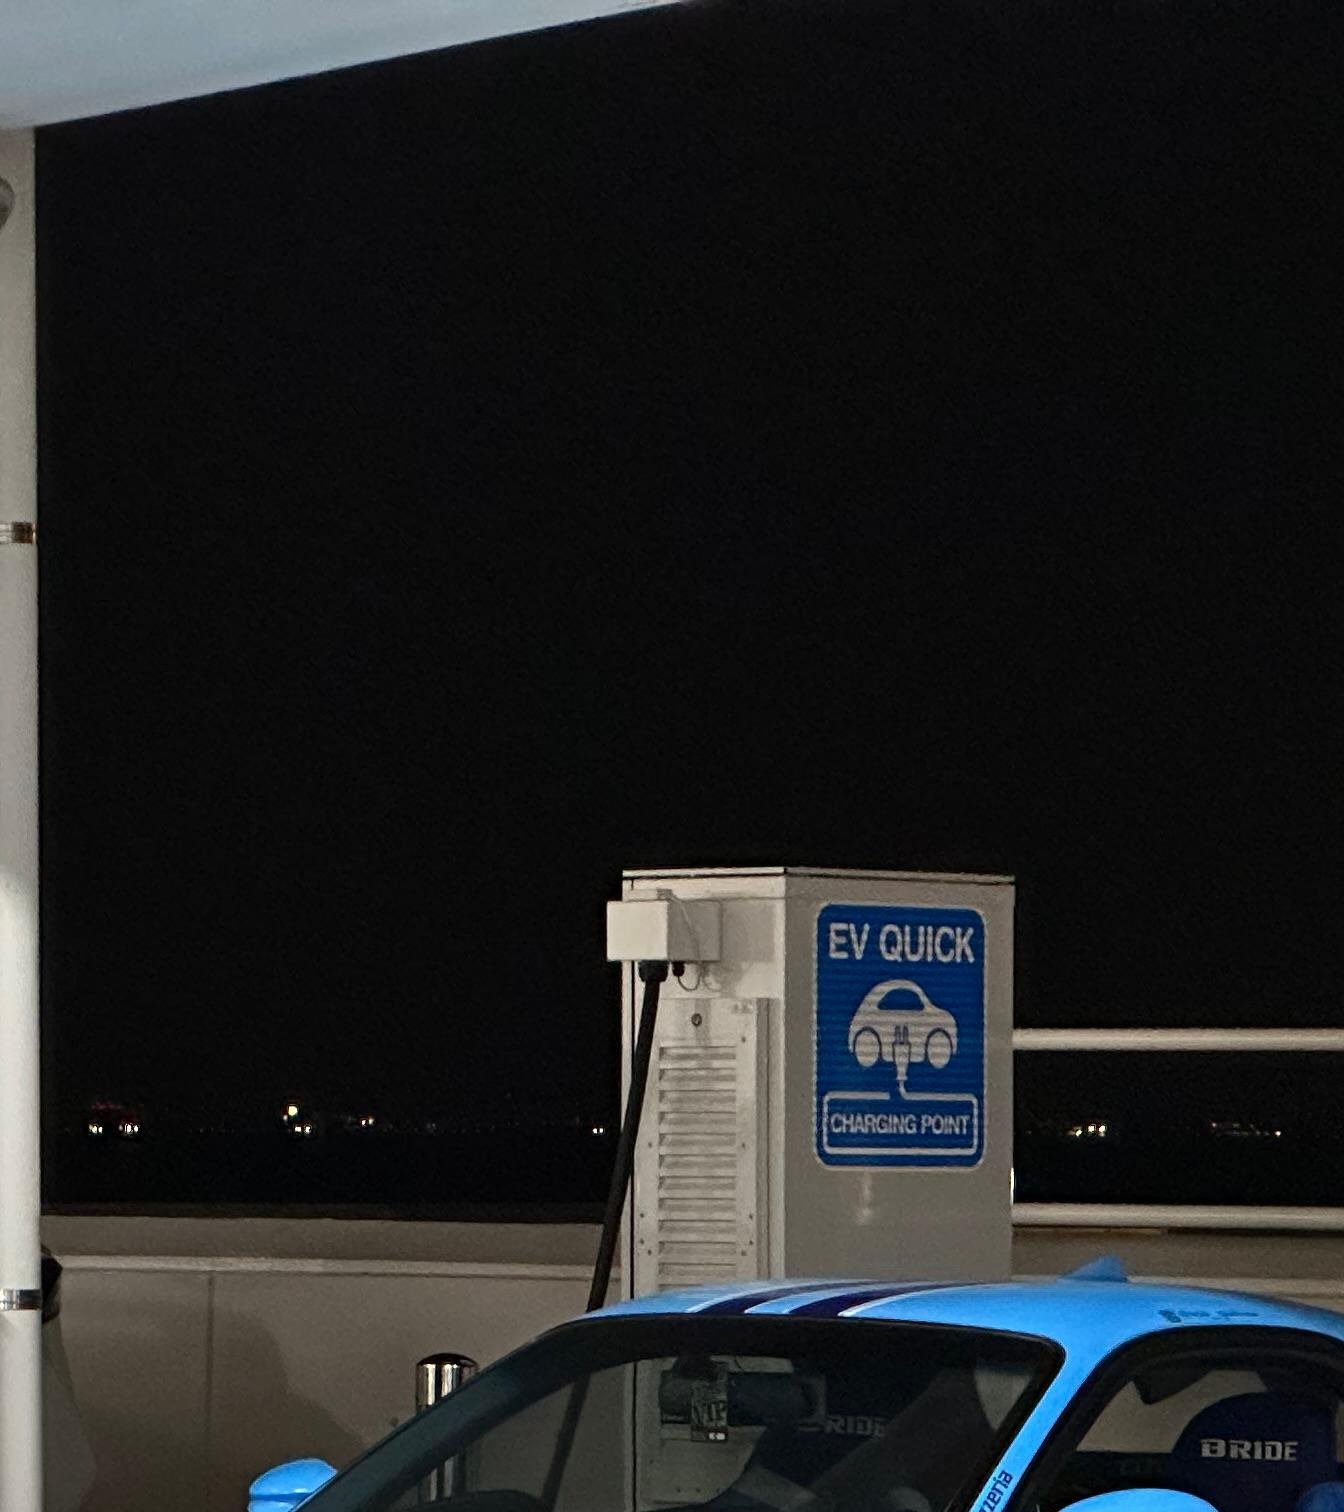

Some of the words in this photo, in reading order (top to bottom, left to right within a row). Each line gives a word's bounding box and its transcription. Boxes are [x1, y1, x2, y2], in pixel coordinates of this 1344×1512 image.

[828, 921, 869, 961] EV
[878, 923, 975, 964] QUICK
[830, 1111, 917, 1135] CHARGING
[920, 1113, 971, 1136] POINT
[1199, 1438, 1298, 1461] BRIDE
